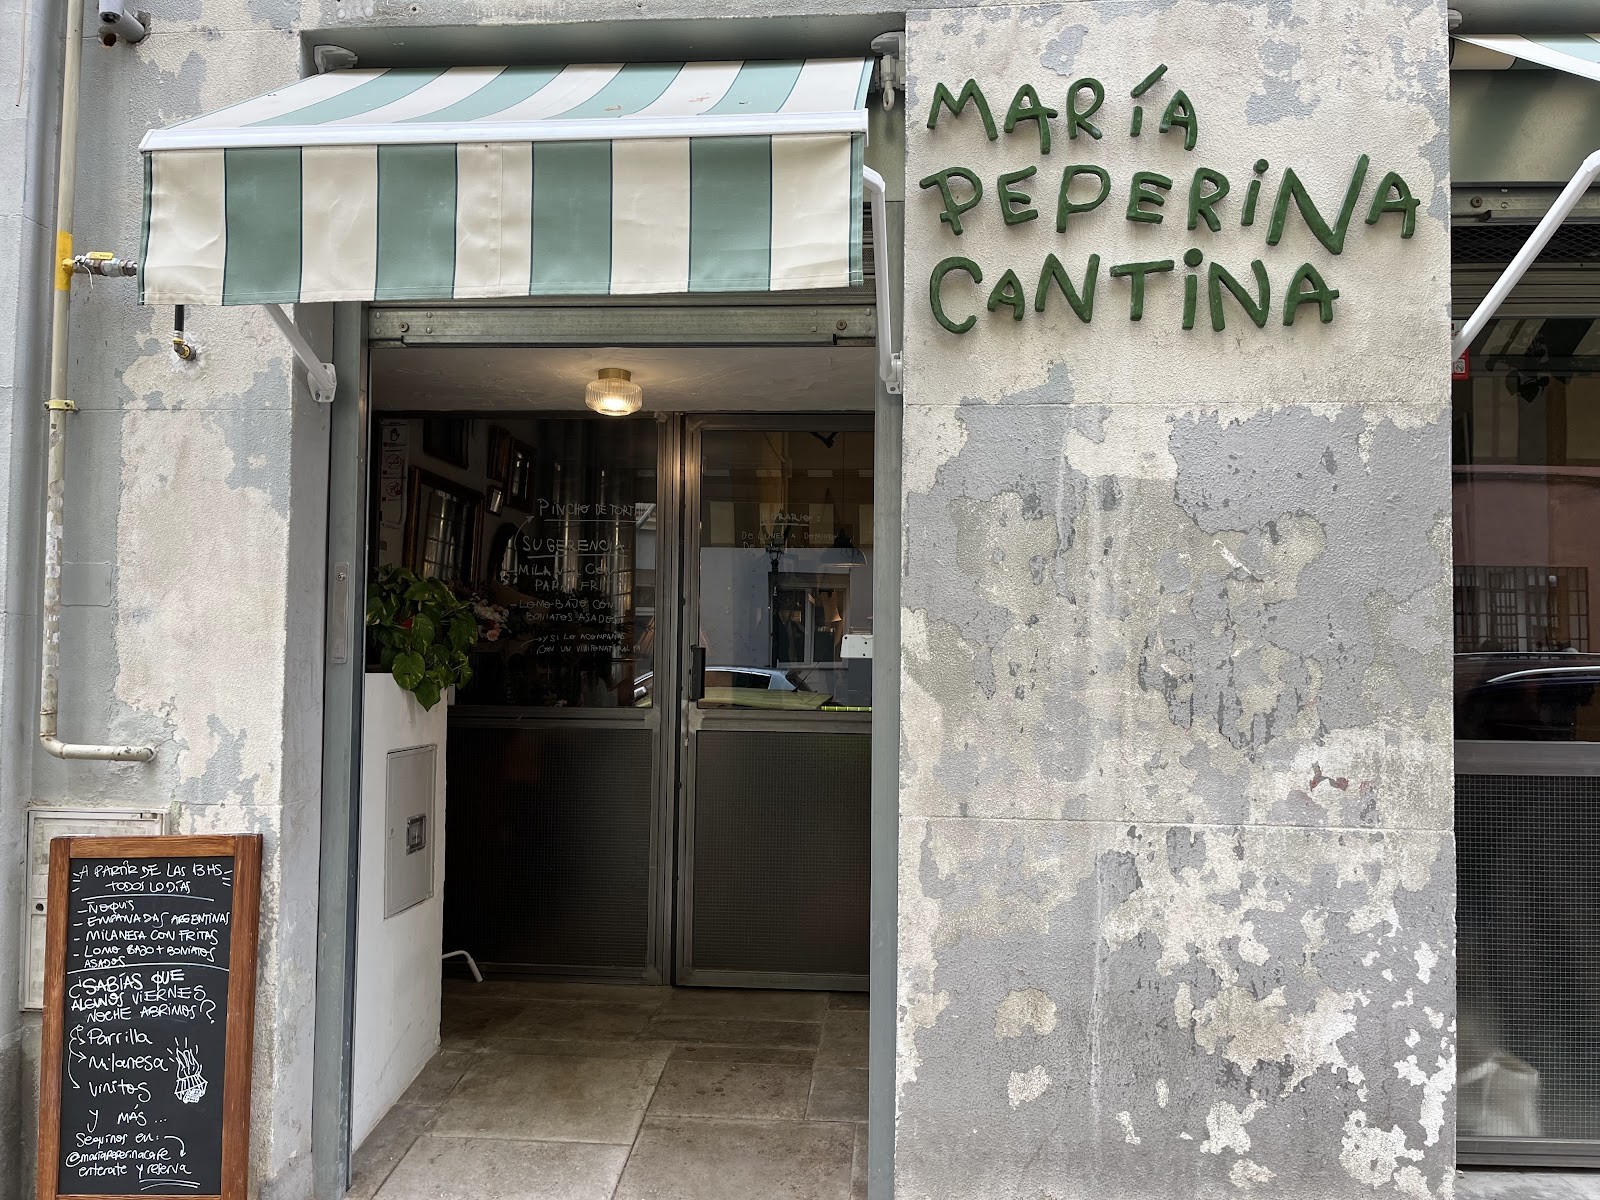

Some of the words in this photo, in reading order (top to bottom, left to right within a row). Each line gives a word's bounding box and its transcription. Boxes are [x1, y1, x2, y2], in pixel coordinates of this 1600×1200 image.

[926, 63, 1199, 155] MARÍA
[139, 864, 162, 879] DE
[166, 863, 186, 877] LAS
[150, 930, 176, 941] CON
[84, 945, 122, 957] LOMO
[83, 956, 126, 969] ASADOS
[150, 969, 185, 991] QUE
[86, 1007, 132, 1024] NOCHE
